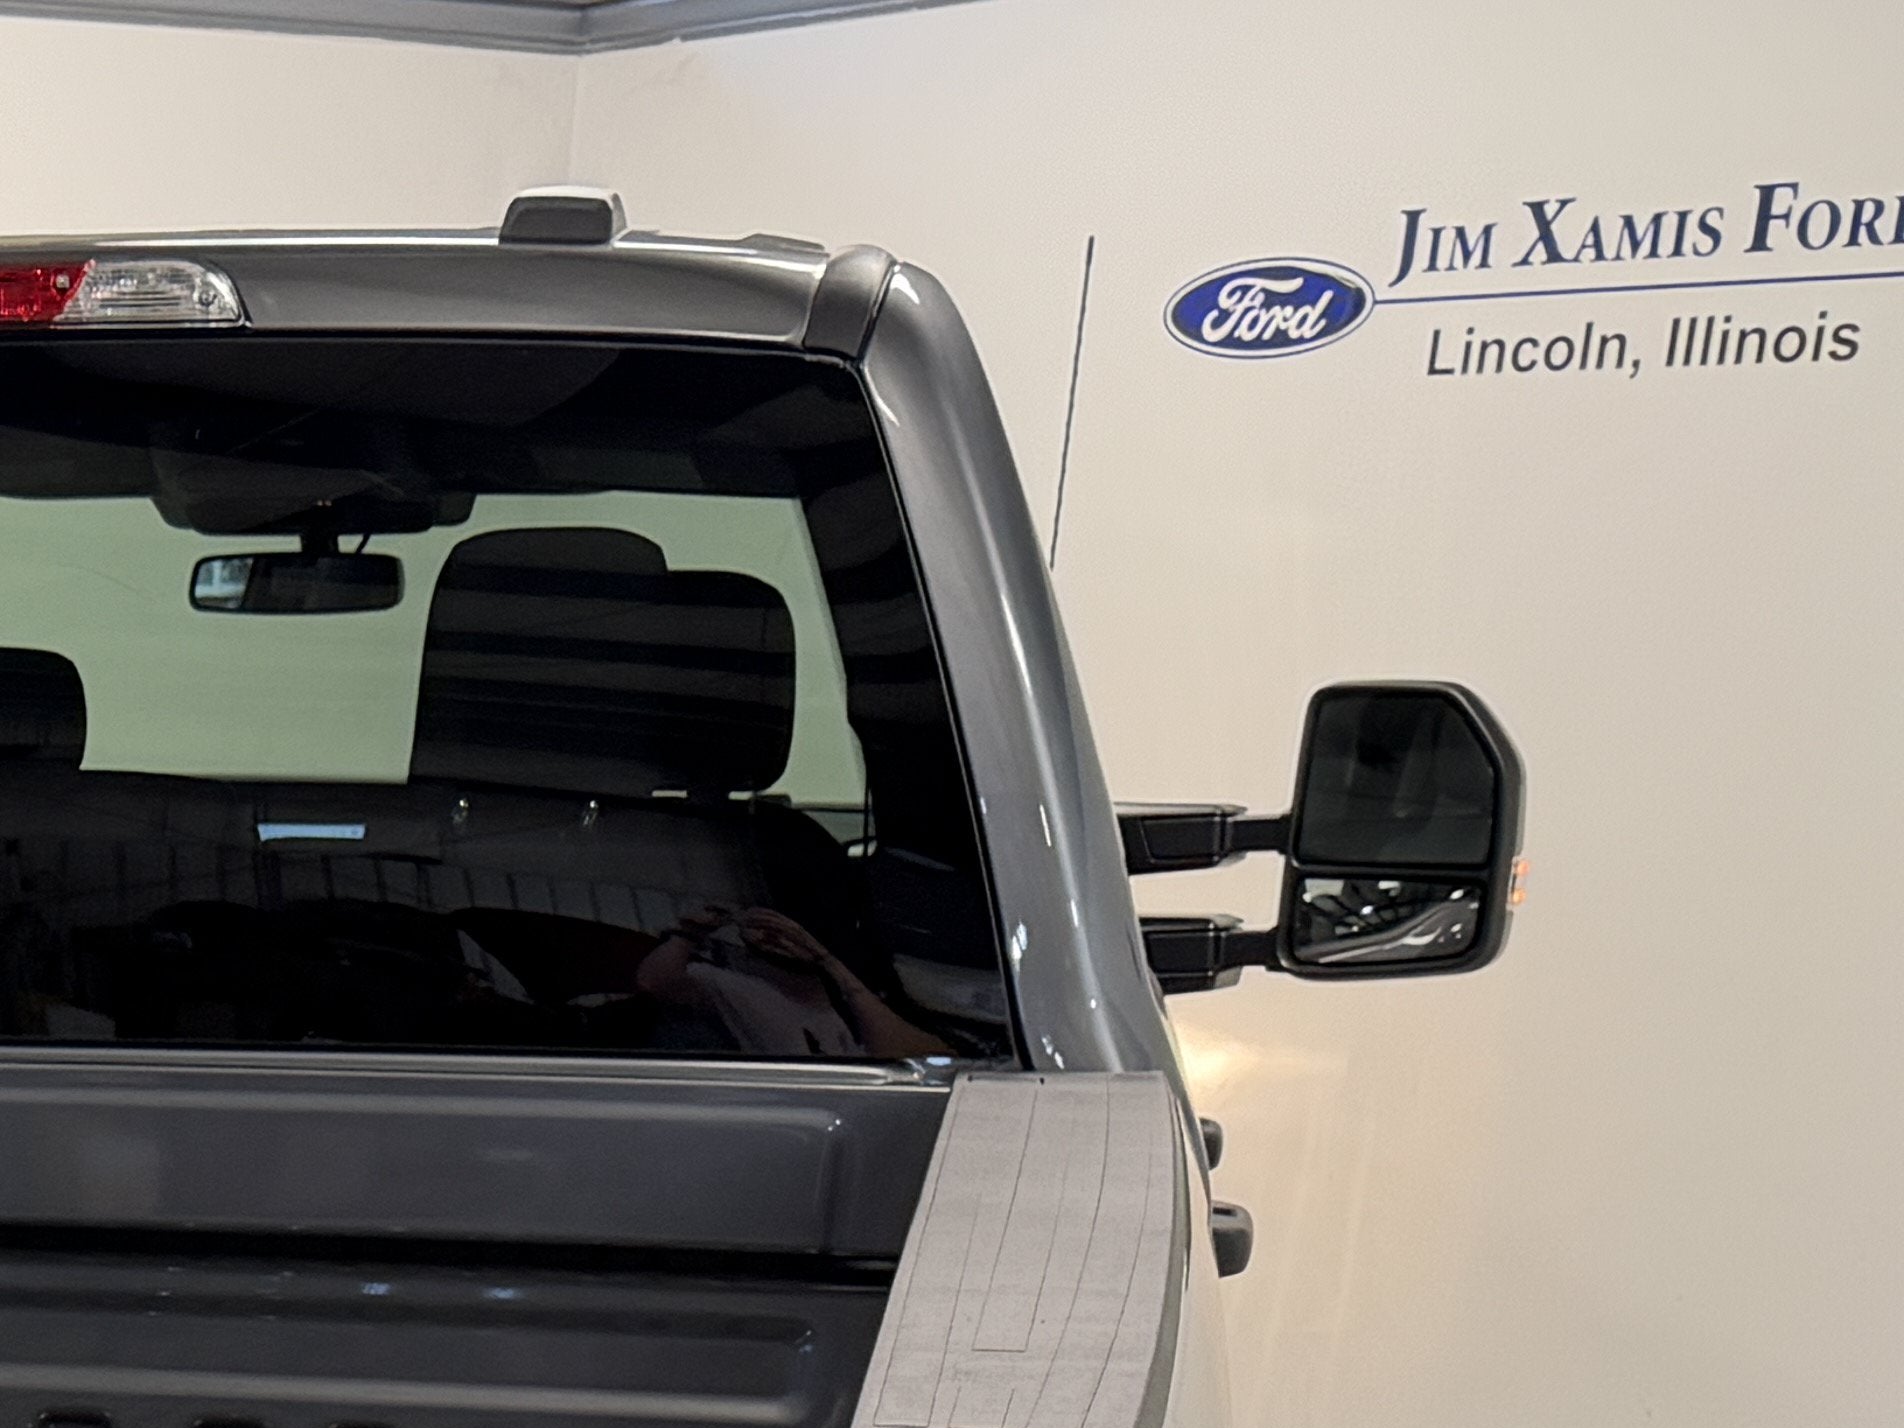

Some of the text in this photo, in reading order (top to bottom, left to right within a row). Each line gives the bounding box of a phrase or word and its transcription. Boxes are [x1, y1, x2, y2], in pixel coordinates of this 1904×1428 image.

[1743, 181, 1904, 254] FOR
[1201, 276, 1334, 343] Ford
[1426, 308, 1861, 380] Lincoln, Illinois
